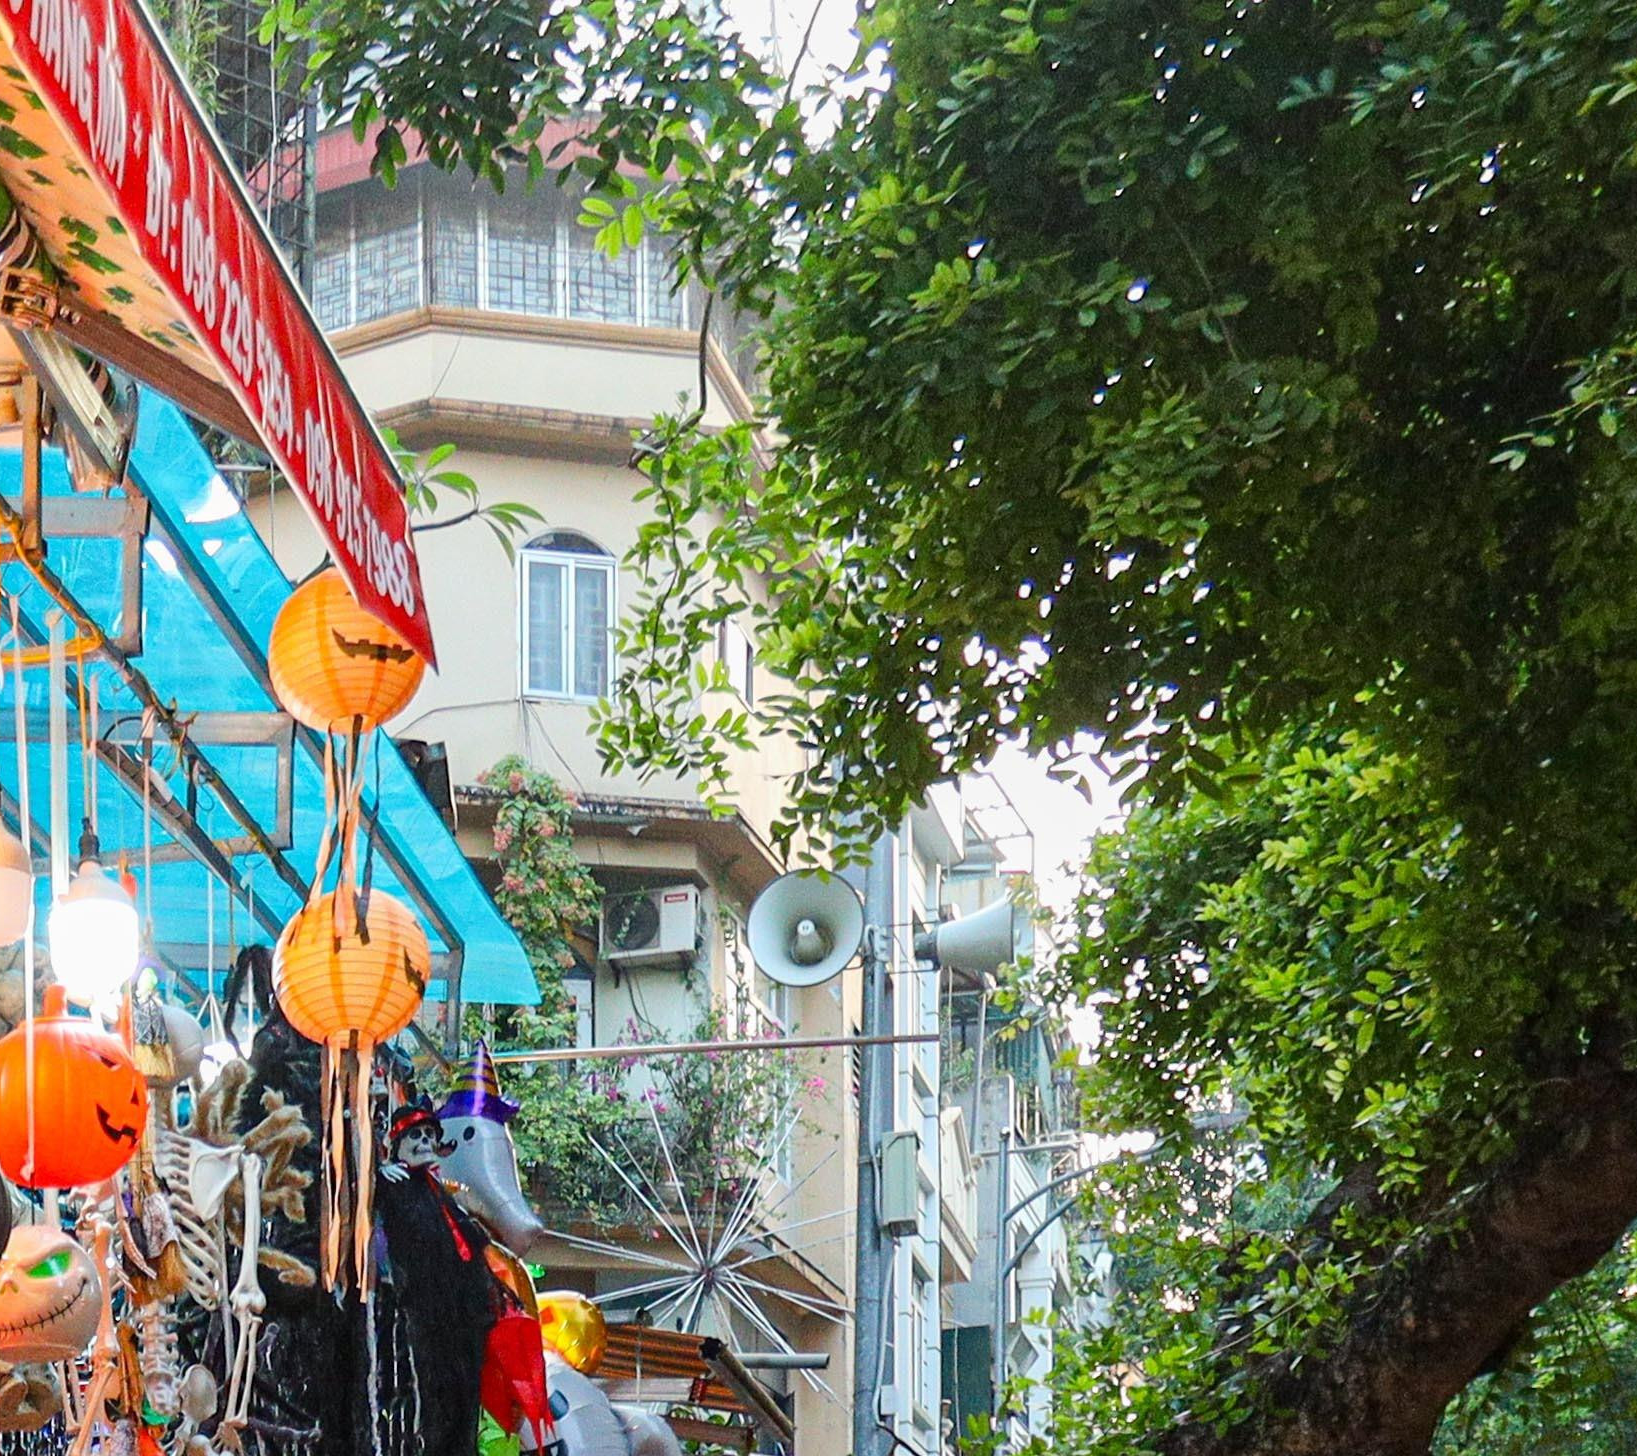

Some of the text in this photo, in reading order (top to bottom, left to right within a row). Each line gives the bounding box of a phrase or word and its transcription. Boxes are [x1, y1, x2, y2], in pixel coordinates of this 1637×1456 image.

[181, 199, 216, 330] 098
[219, 262, 253, 388] 229
[256, 320, 294, 458] 5254
[304, 410, 333, 523] 096
[335, 465, 364, 566] 915
[364, 522, 416, 617] 7988
